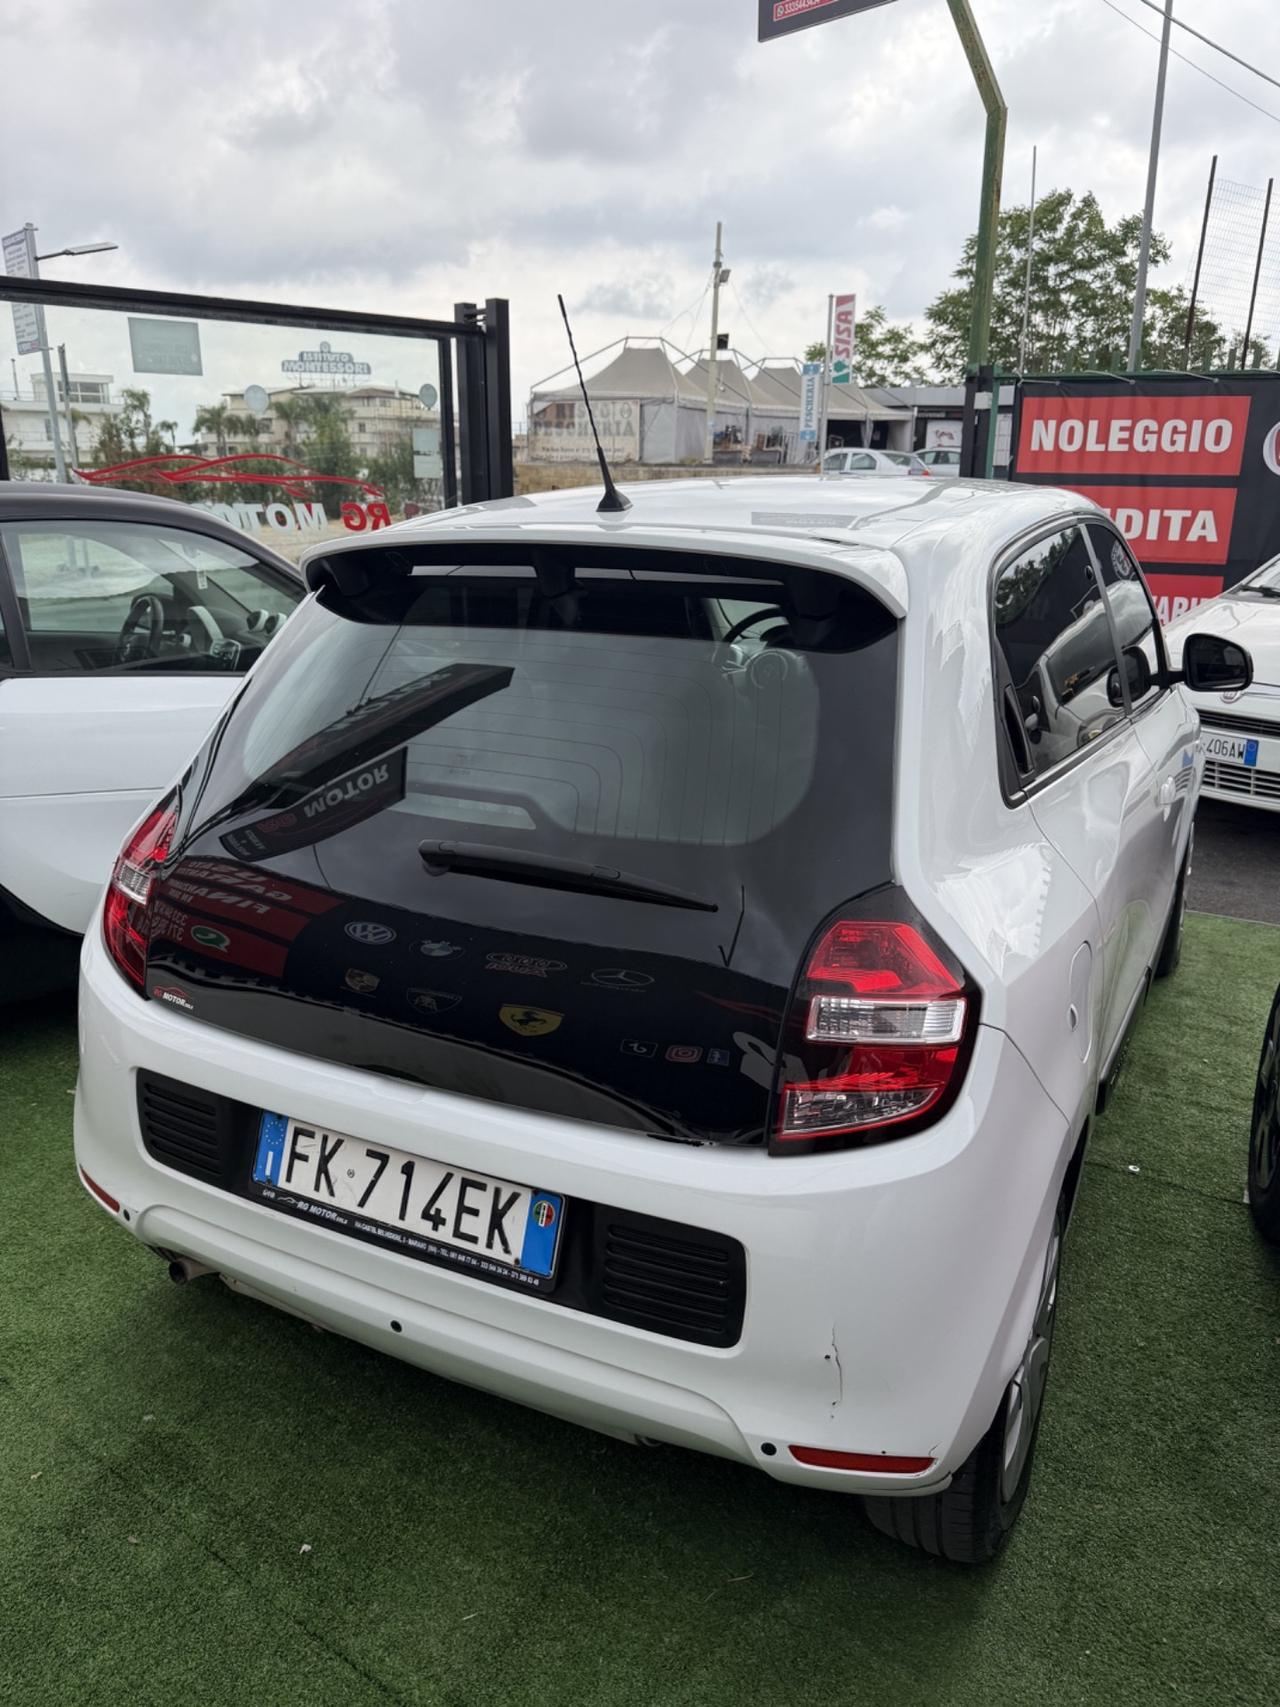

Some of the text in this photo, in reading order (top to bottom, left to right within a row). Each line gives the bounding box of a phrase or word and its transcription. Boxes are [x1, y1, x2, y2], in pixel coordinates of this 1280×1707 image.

[834, 309, 853, 359] SISA
[283, 361, 369, 376] MONTESSORI
[303, 352, 350, 363] ISTITUTO
[1030, 418, 1233, 453] NOLEGGIO
[1107, 508, 1219, 543] DITA
[1206, 738, 1245, 760] 406AW
[162, 992, 186, 1006] MOTOR
[285, 1126, 522, 1256] FK 714EK
[310, 1205, 337, 1220] MOTOR
